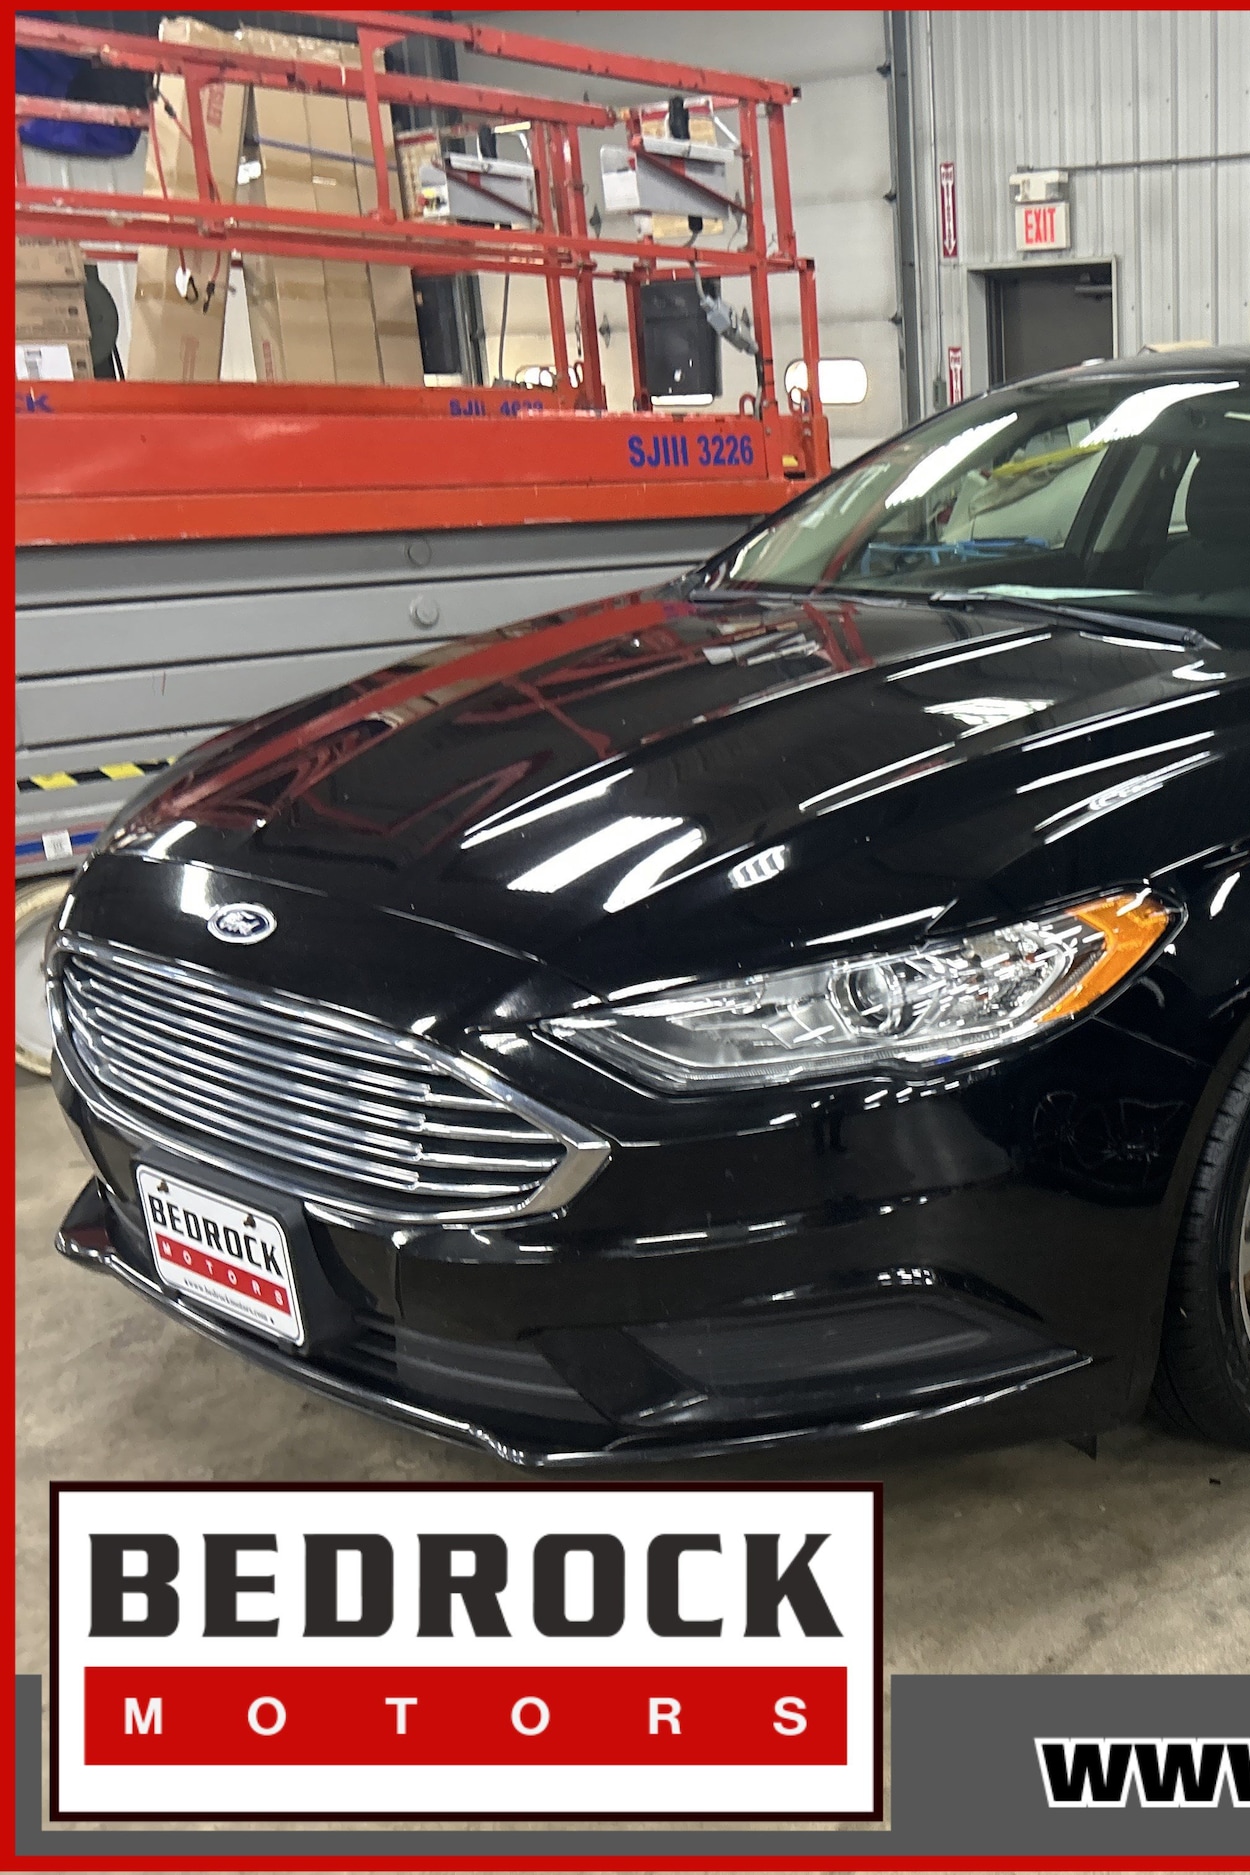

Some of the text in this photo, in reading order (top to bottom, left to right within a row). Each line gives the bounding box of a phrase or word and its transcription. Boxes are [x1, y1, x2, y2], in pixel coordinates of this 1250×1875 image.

[1024, 207, 1056, 244] EXIT
[628, 434, 754, 468] SJIII 3226
[148, 1194, 284, 1280] BEDROCK
[162, 1241, 284, 1306] MOTORS
